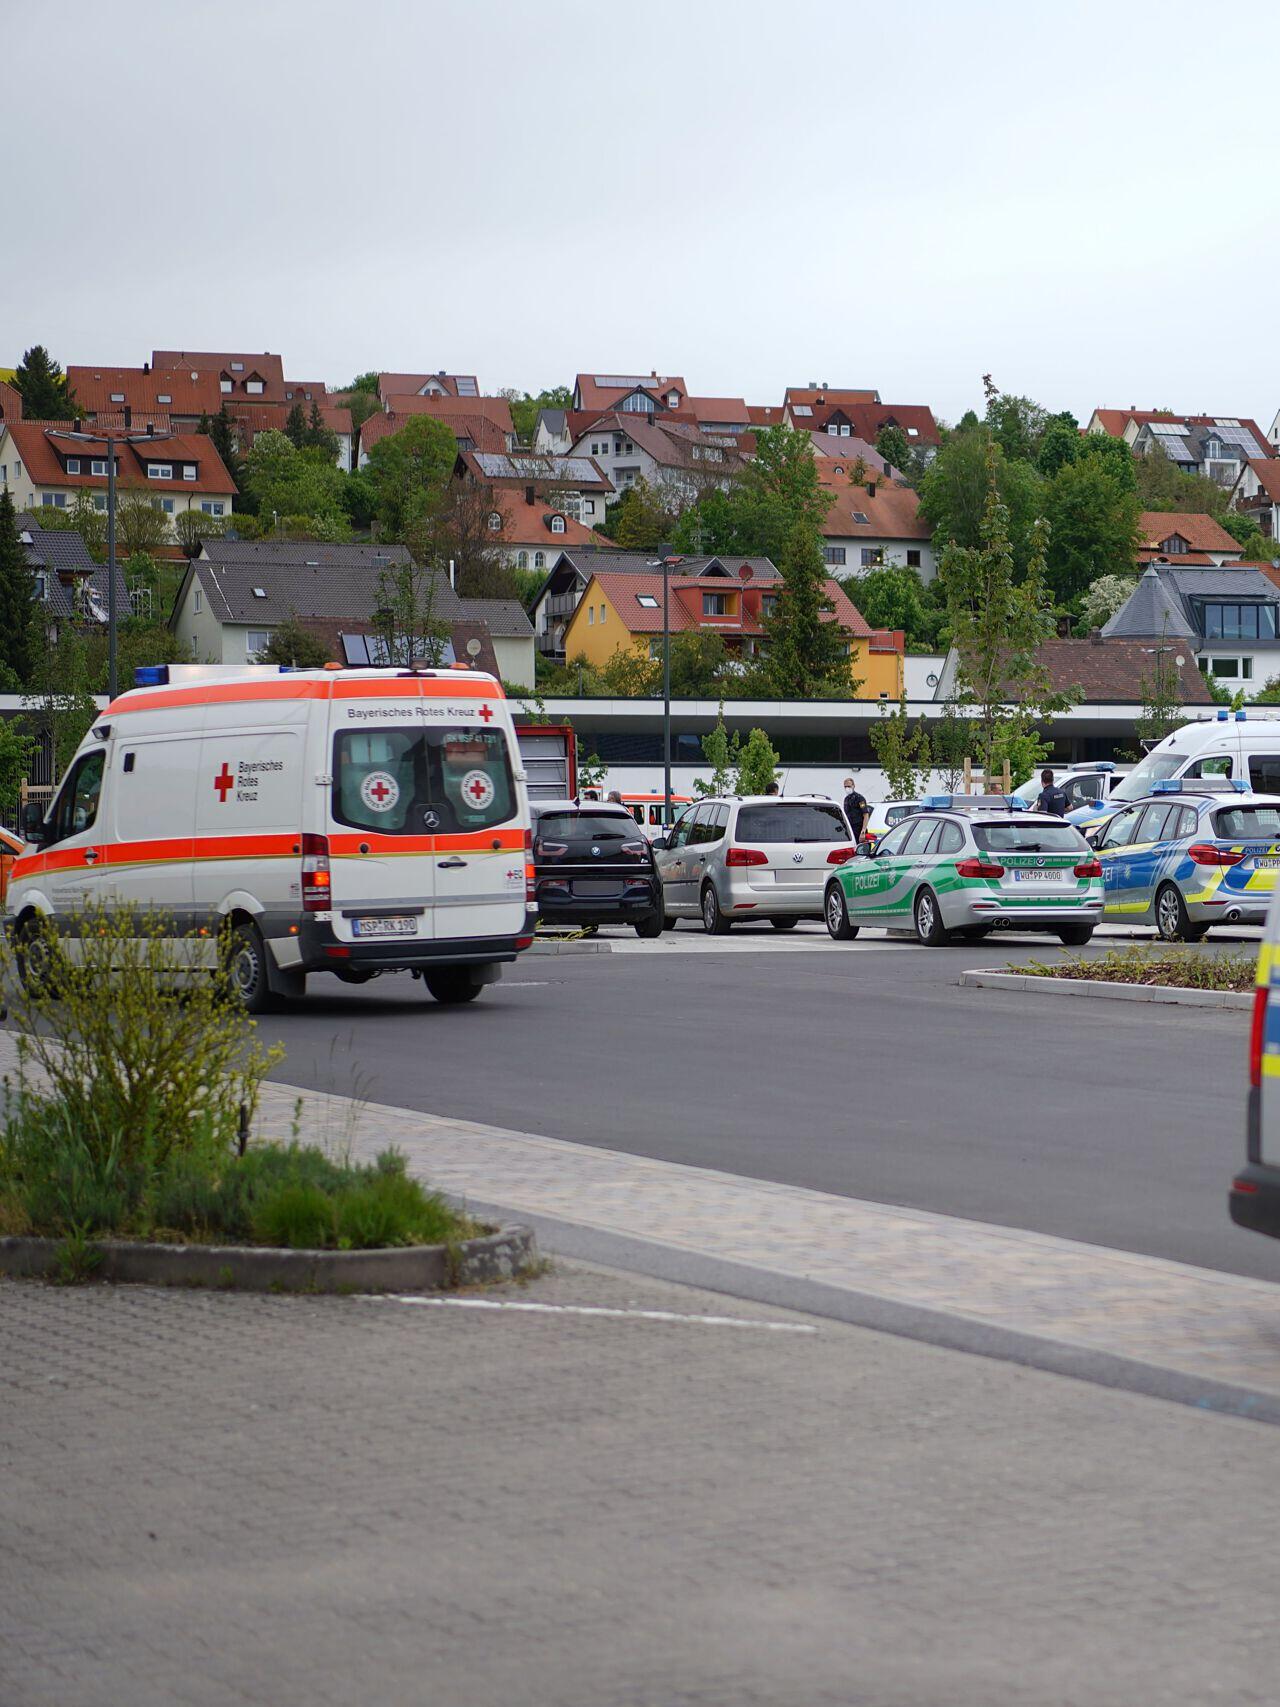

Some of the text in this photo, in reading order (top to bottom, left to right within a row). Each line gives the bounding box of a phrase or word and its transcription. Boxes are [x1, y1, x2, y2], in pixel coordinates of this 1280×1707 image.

[347, 706, 475, 720] Bayerisches Rotes Kreuz
[238, 761, 284, 775] Bayerisches
[238, 776, 259, 787] Rotes
[237, 790, 258, 801] Kreuz
[1245, 846, 1268, 854] POLIZEI
[1000, 857, 1036, 866] POLIZEI
[855, 874, 880, 890] POLIZEI
[360, 919, 415, 932] MSP RK 190
